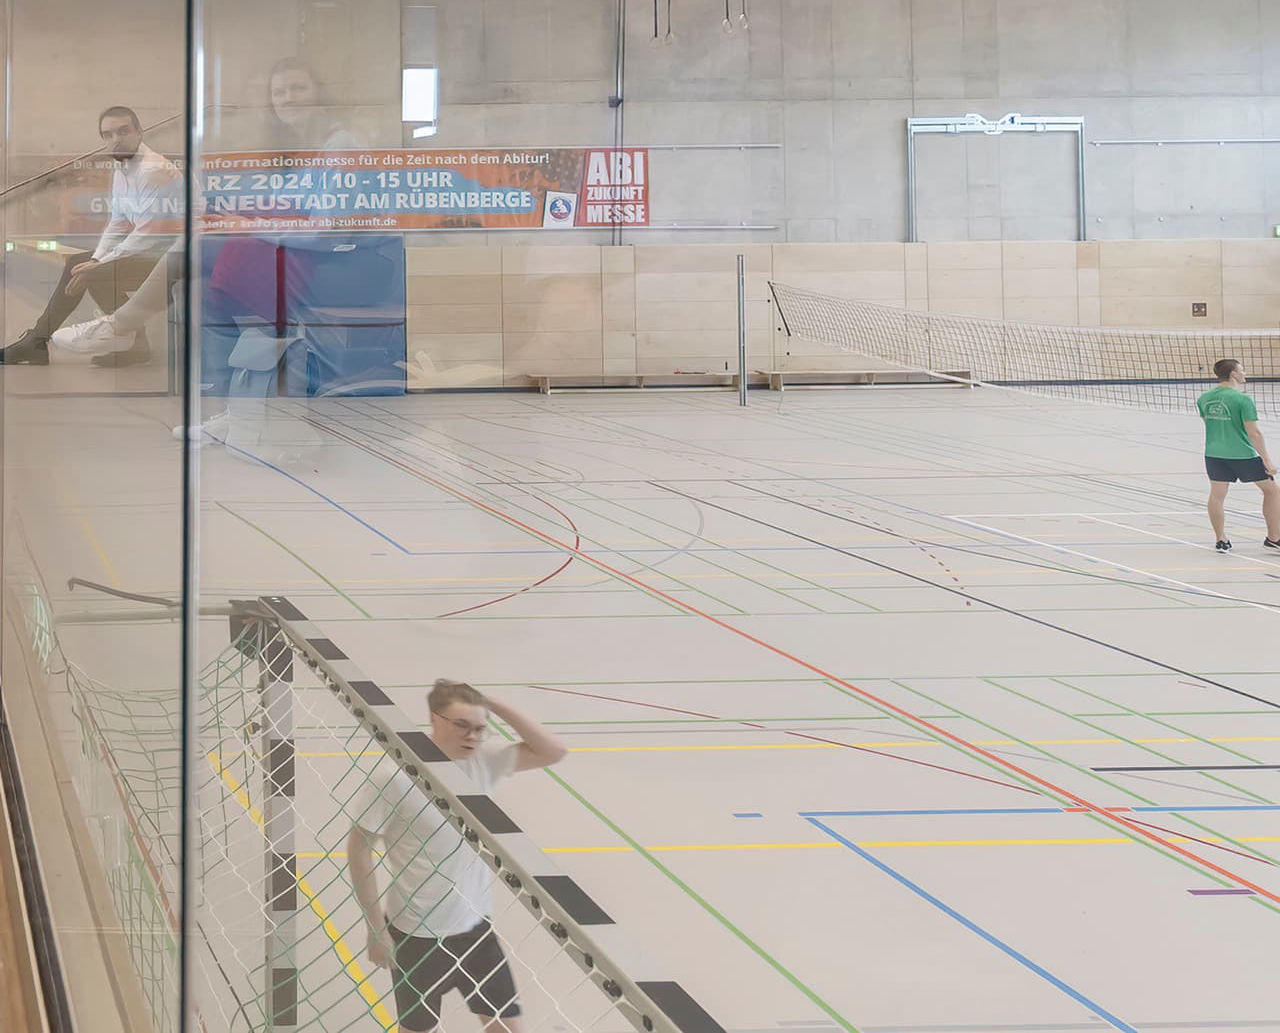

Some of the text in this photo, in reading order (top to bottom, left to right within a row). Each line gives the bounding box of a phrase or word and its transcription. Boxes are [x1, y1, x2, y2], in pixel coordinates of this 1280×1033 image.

[359, 154, 379, 165] für
[382, 154, 403, 165] die
[406, 154, 432, 165] Zeit
[435, 153, 467, 165] nach
[471, 153, 500, 165] dem
[503, 153, 550, 164] Abitur!
[586, 151, 644, 185] ABI
[251, 173, 314, 191] 2024
[332, 172, 357, 189] 10
[376, 172, 401, 188] 15
[407, 172, 454, 188] UHR
[214, 193, 350, 212] NEUSTADT
[354, 192, 390, 209] AM
[395, 188, 532, 209] RÜBENBERGE
[586, 186, 644, 201] ZUKUNFT
[281, 218, 315, 228] unter
[318, 217, 397, 228] abi-zukunft.de
[586, 204, 645, 223] MESSE
